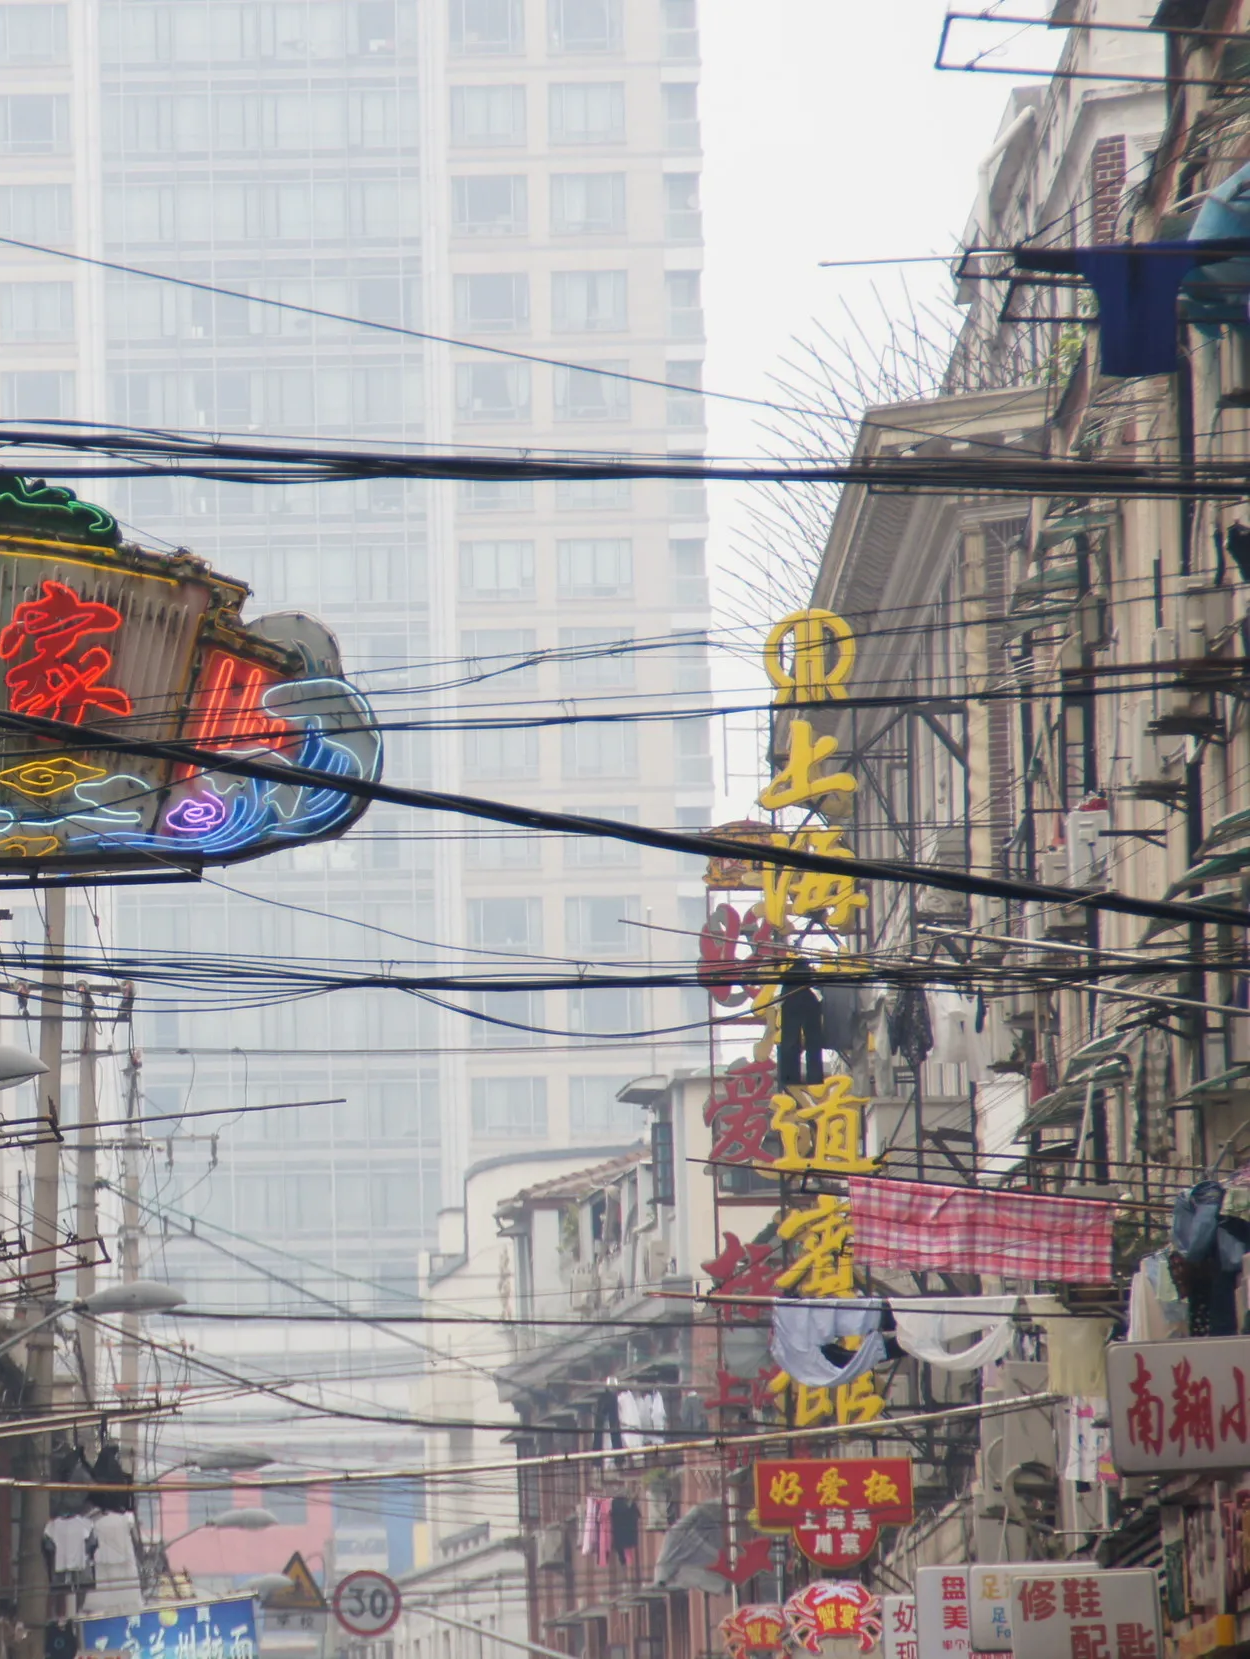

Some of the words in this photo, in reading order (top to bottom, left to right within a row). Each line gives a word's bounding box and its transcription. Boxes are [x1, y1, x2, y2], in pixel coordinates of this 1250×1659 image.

[813, 1532, 861, 1555] 川菜
[349, 1588, 388, 1619] 30
[1018, 1577, 1102, 1621] 修鞋
[1070, 1622, 1156, 1659] 配匙
